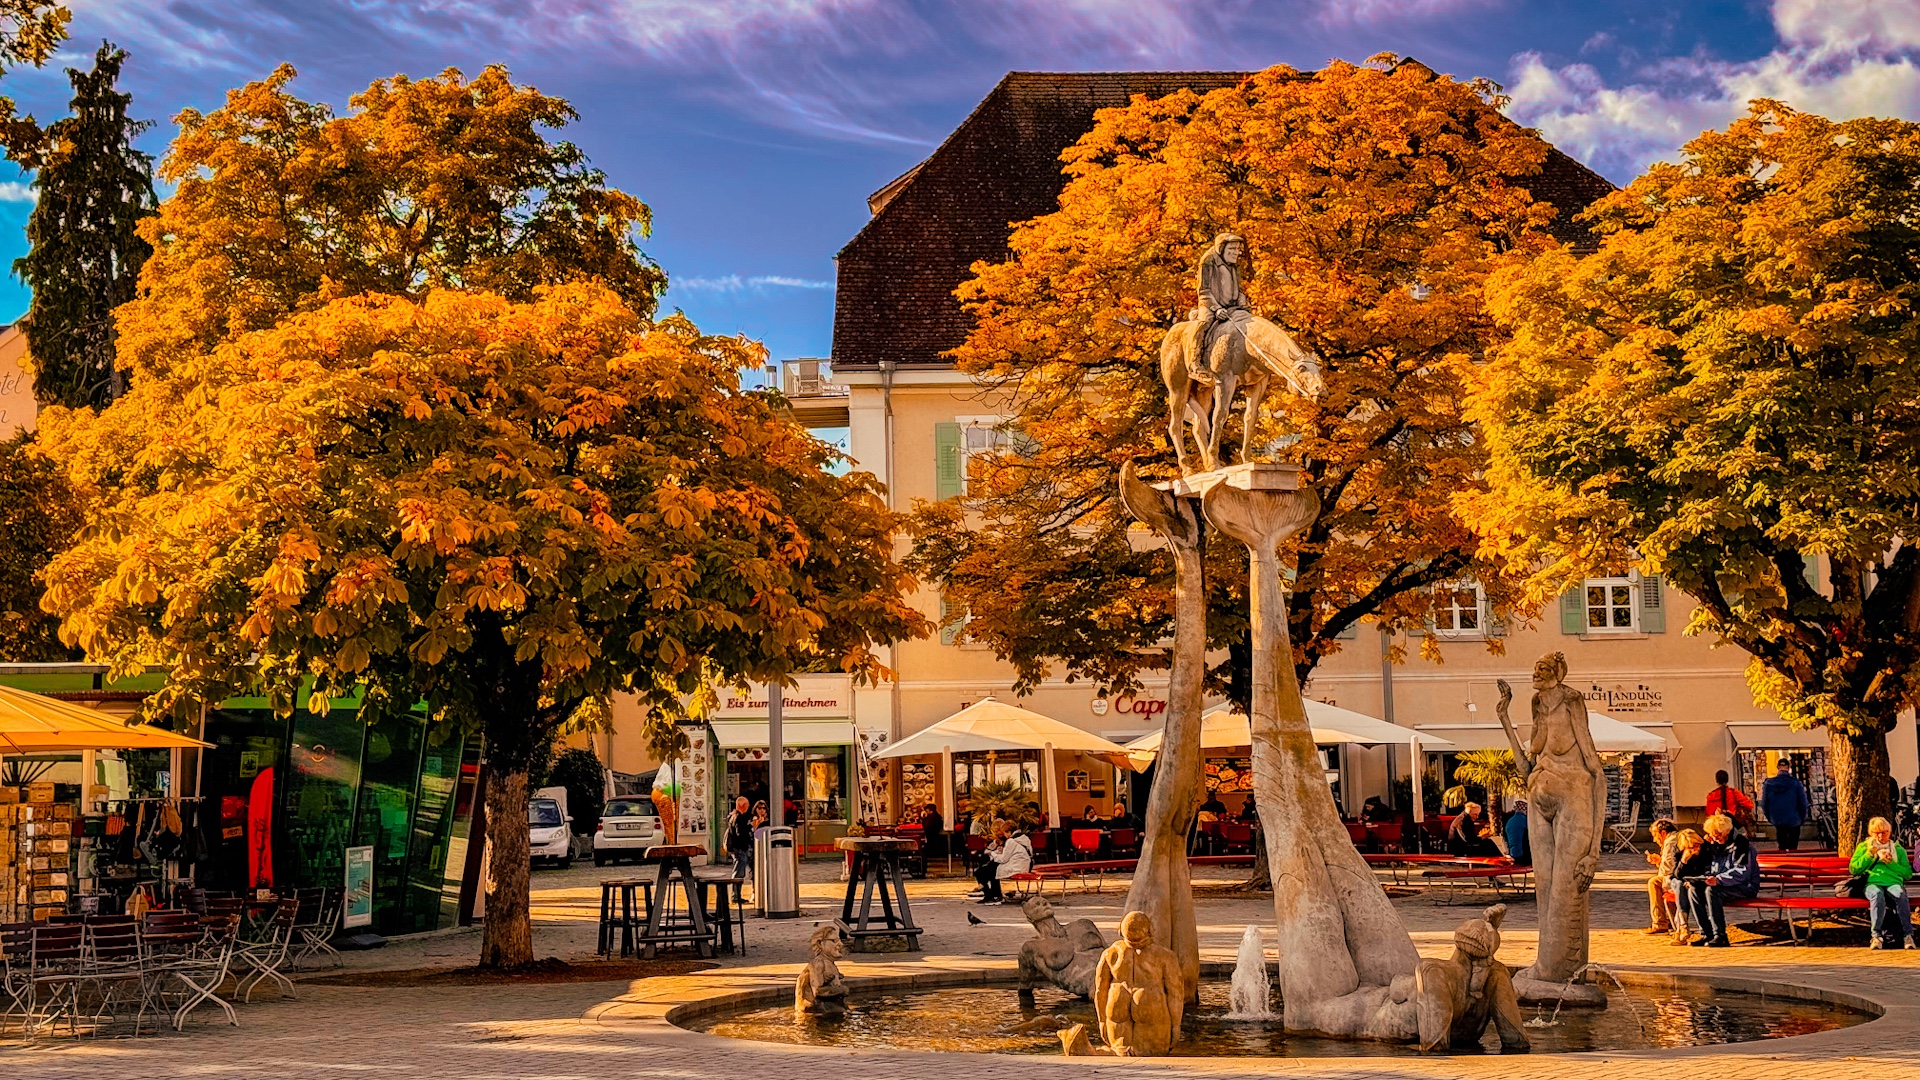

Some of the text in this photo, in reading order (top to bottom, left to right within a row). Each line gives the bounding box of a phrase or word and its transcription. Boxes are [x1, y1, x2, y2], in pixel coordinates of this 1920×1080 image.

[726, 698, 744, 709] Eis
[782, 698, 837, 708] itnehmen
[1584, 691, 1662, 707] UCHLANDUNG
